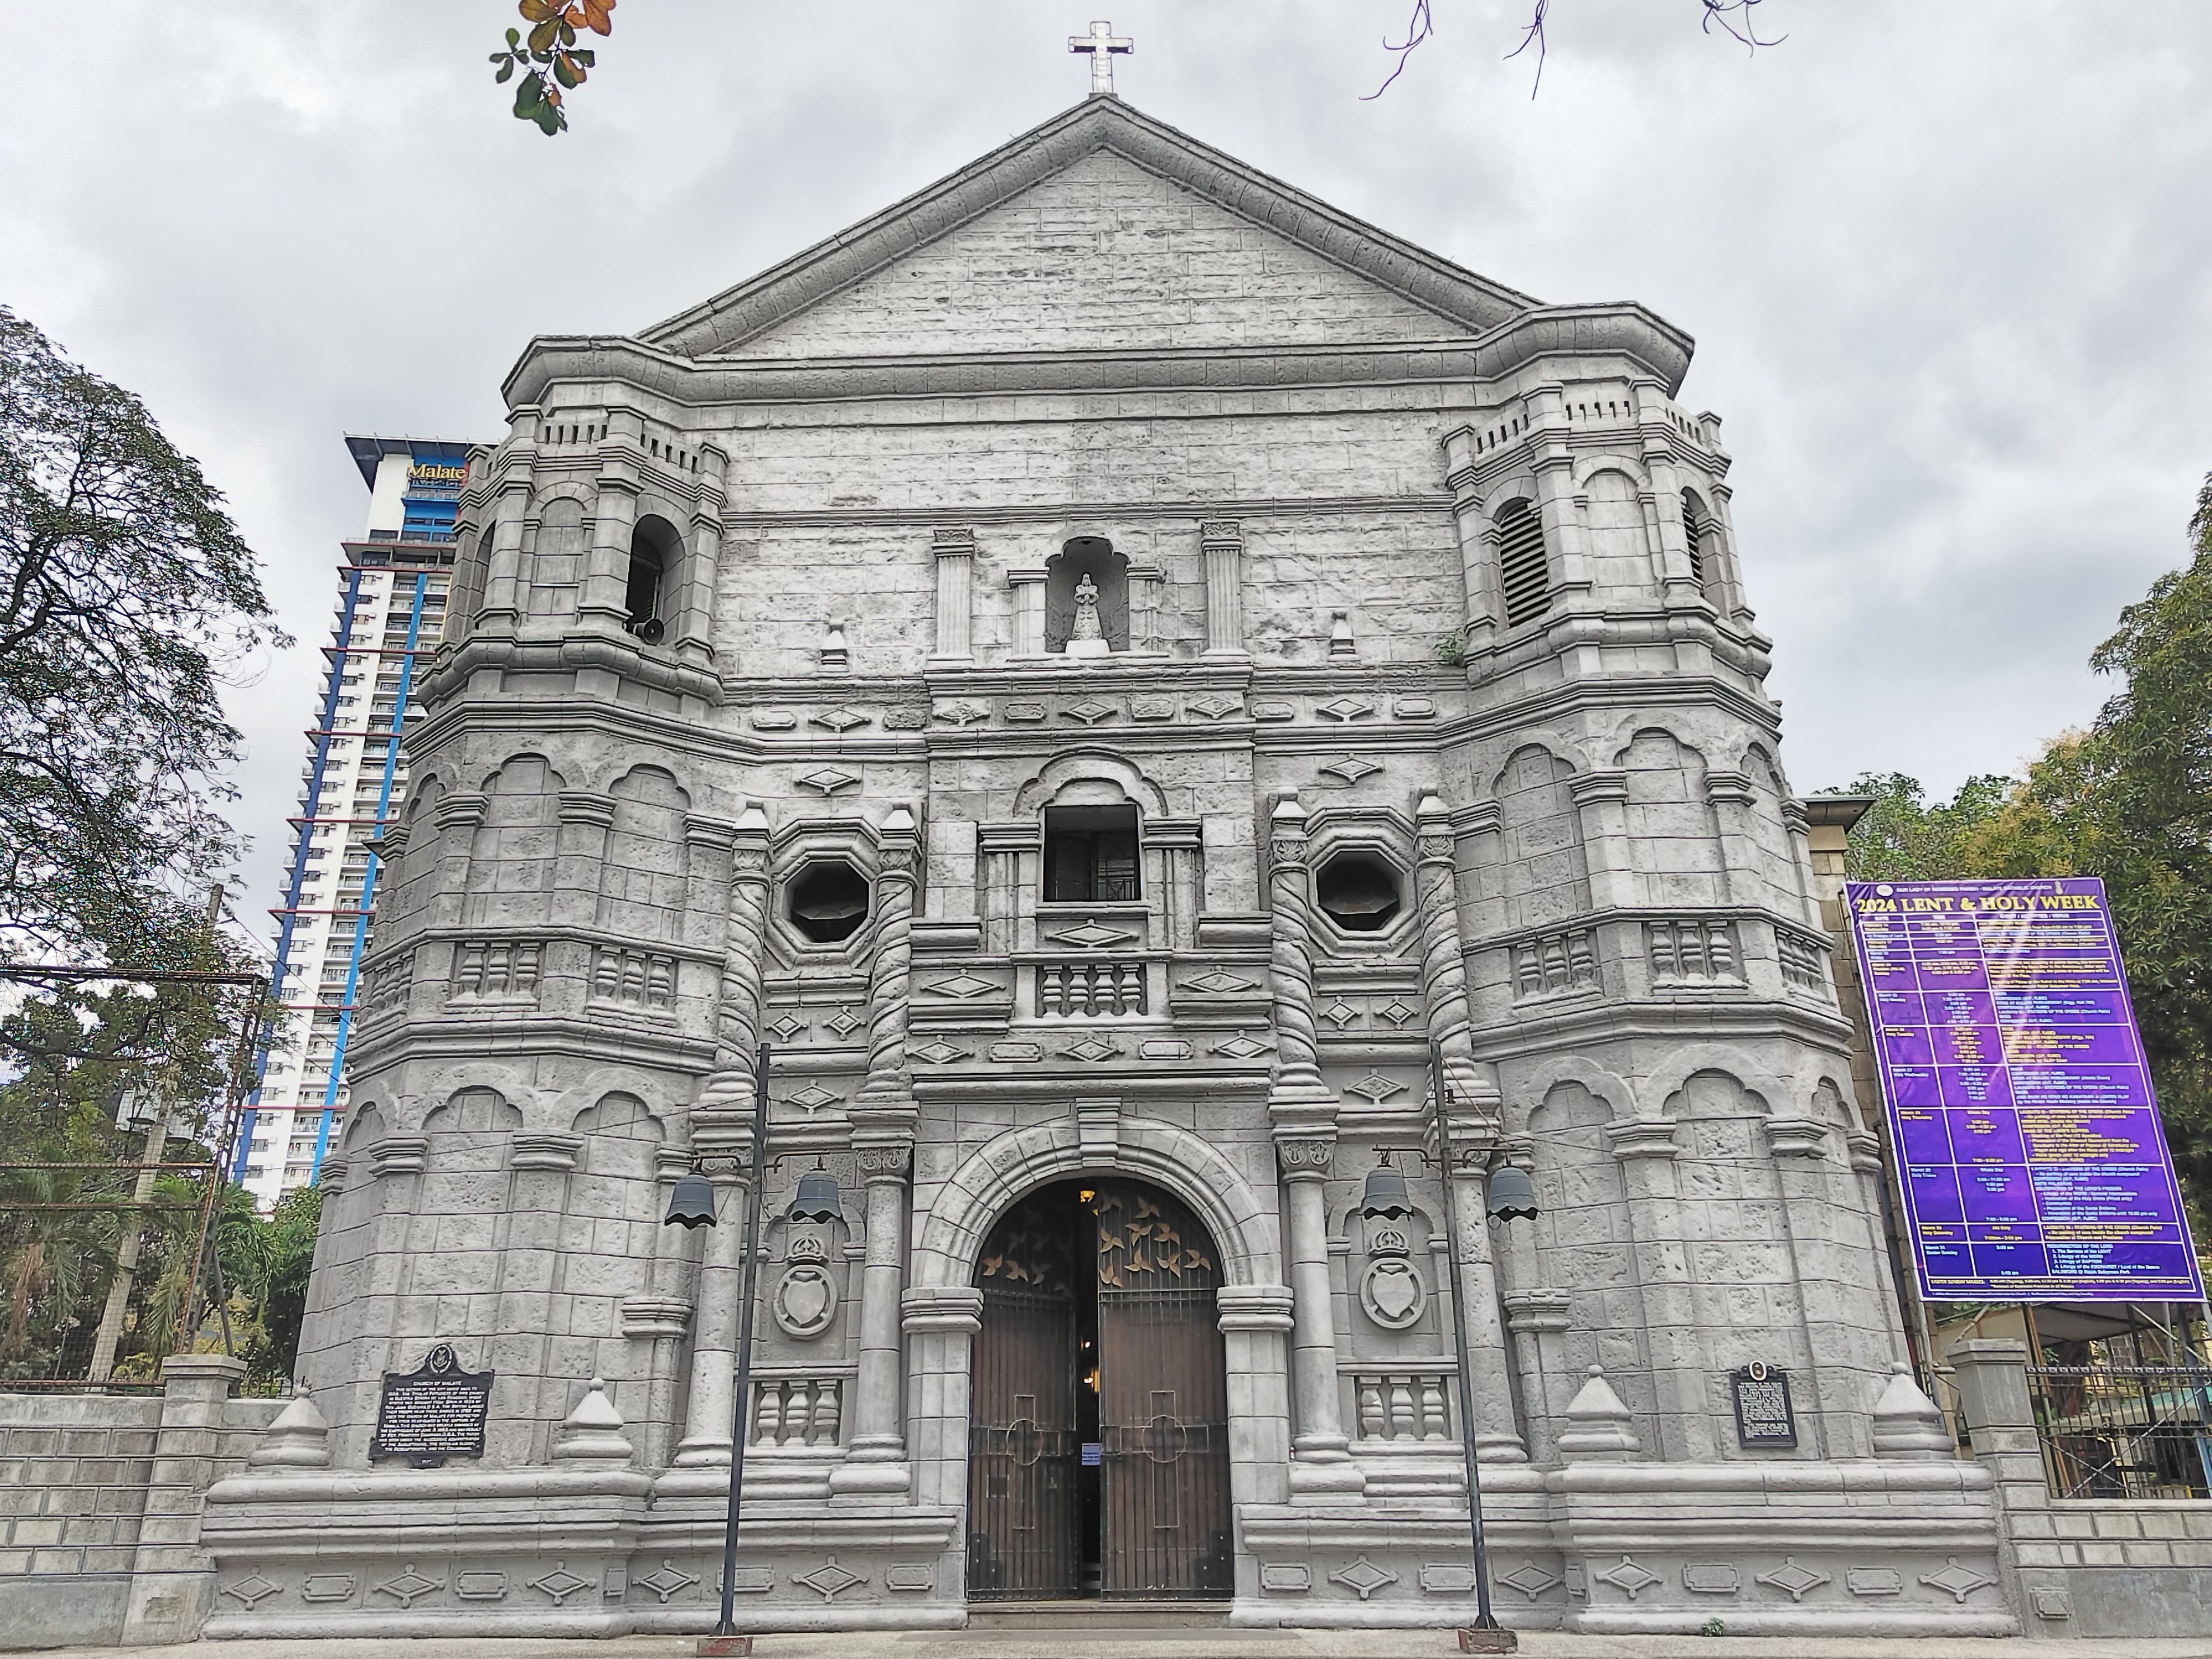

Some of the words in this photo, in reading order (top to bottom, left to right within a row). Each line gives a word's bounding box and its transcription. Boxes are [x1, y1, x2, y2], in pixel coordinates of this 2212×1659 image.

[407, 463, 466, 479] Malate
[1856, 898, 1897, 913] 2024
[1900, 897, 1954, 911] LENT
[1960, 897, 1976, 911] &
[1979, 896, 2036, 910] HOLY
[2040, 895, 2101, 910] WEEK
